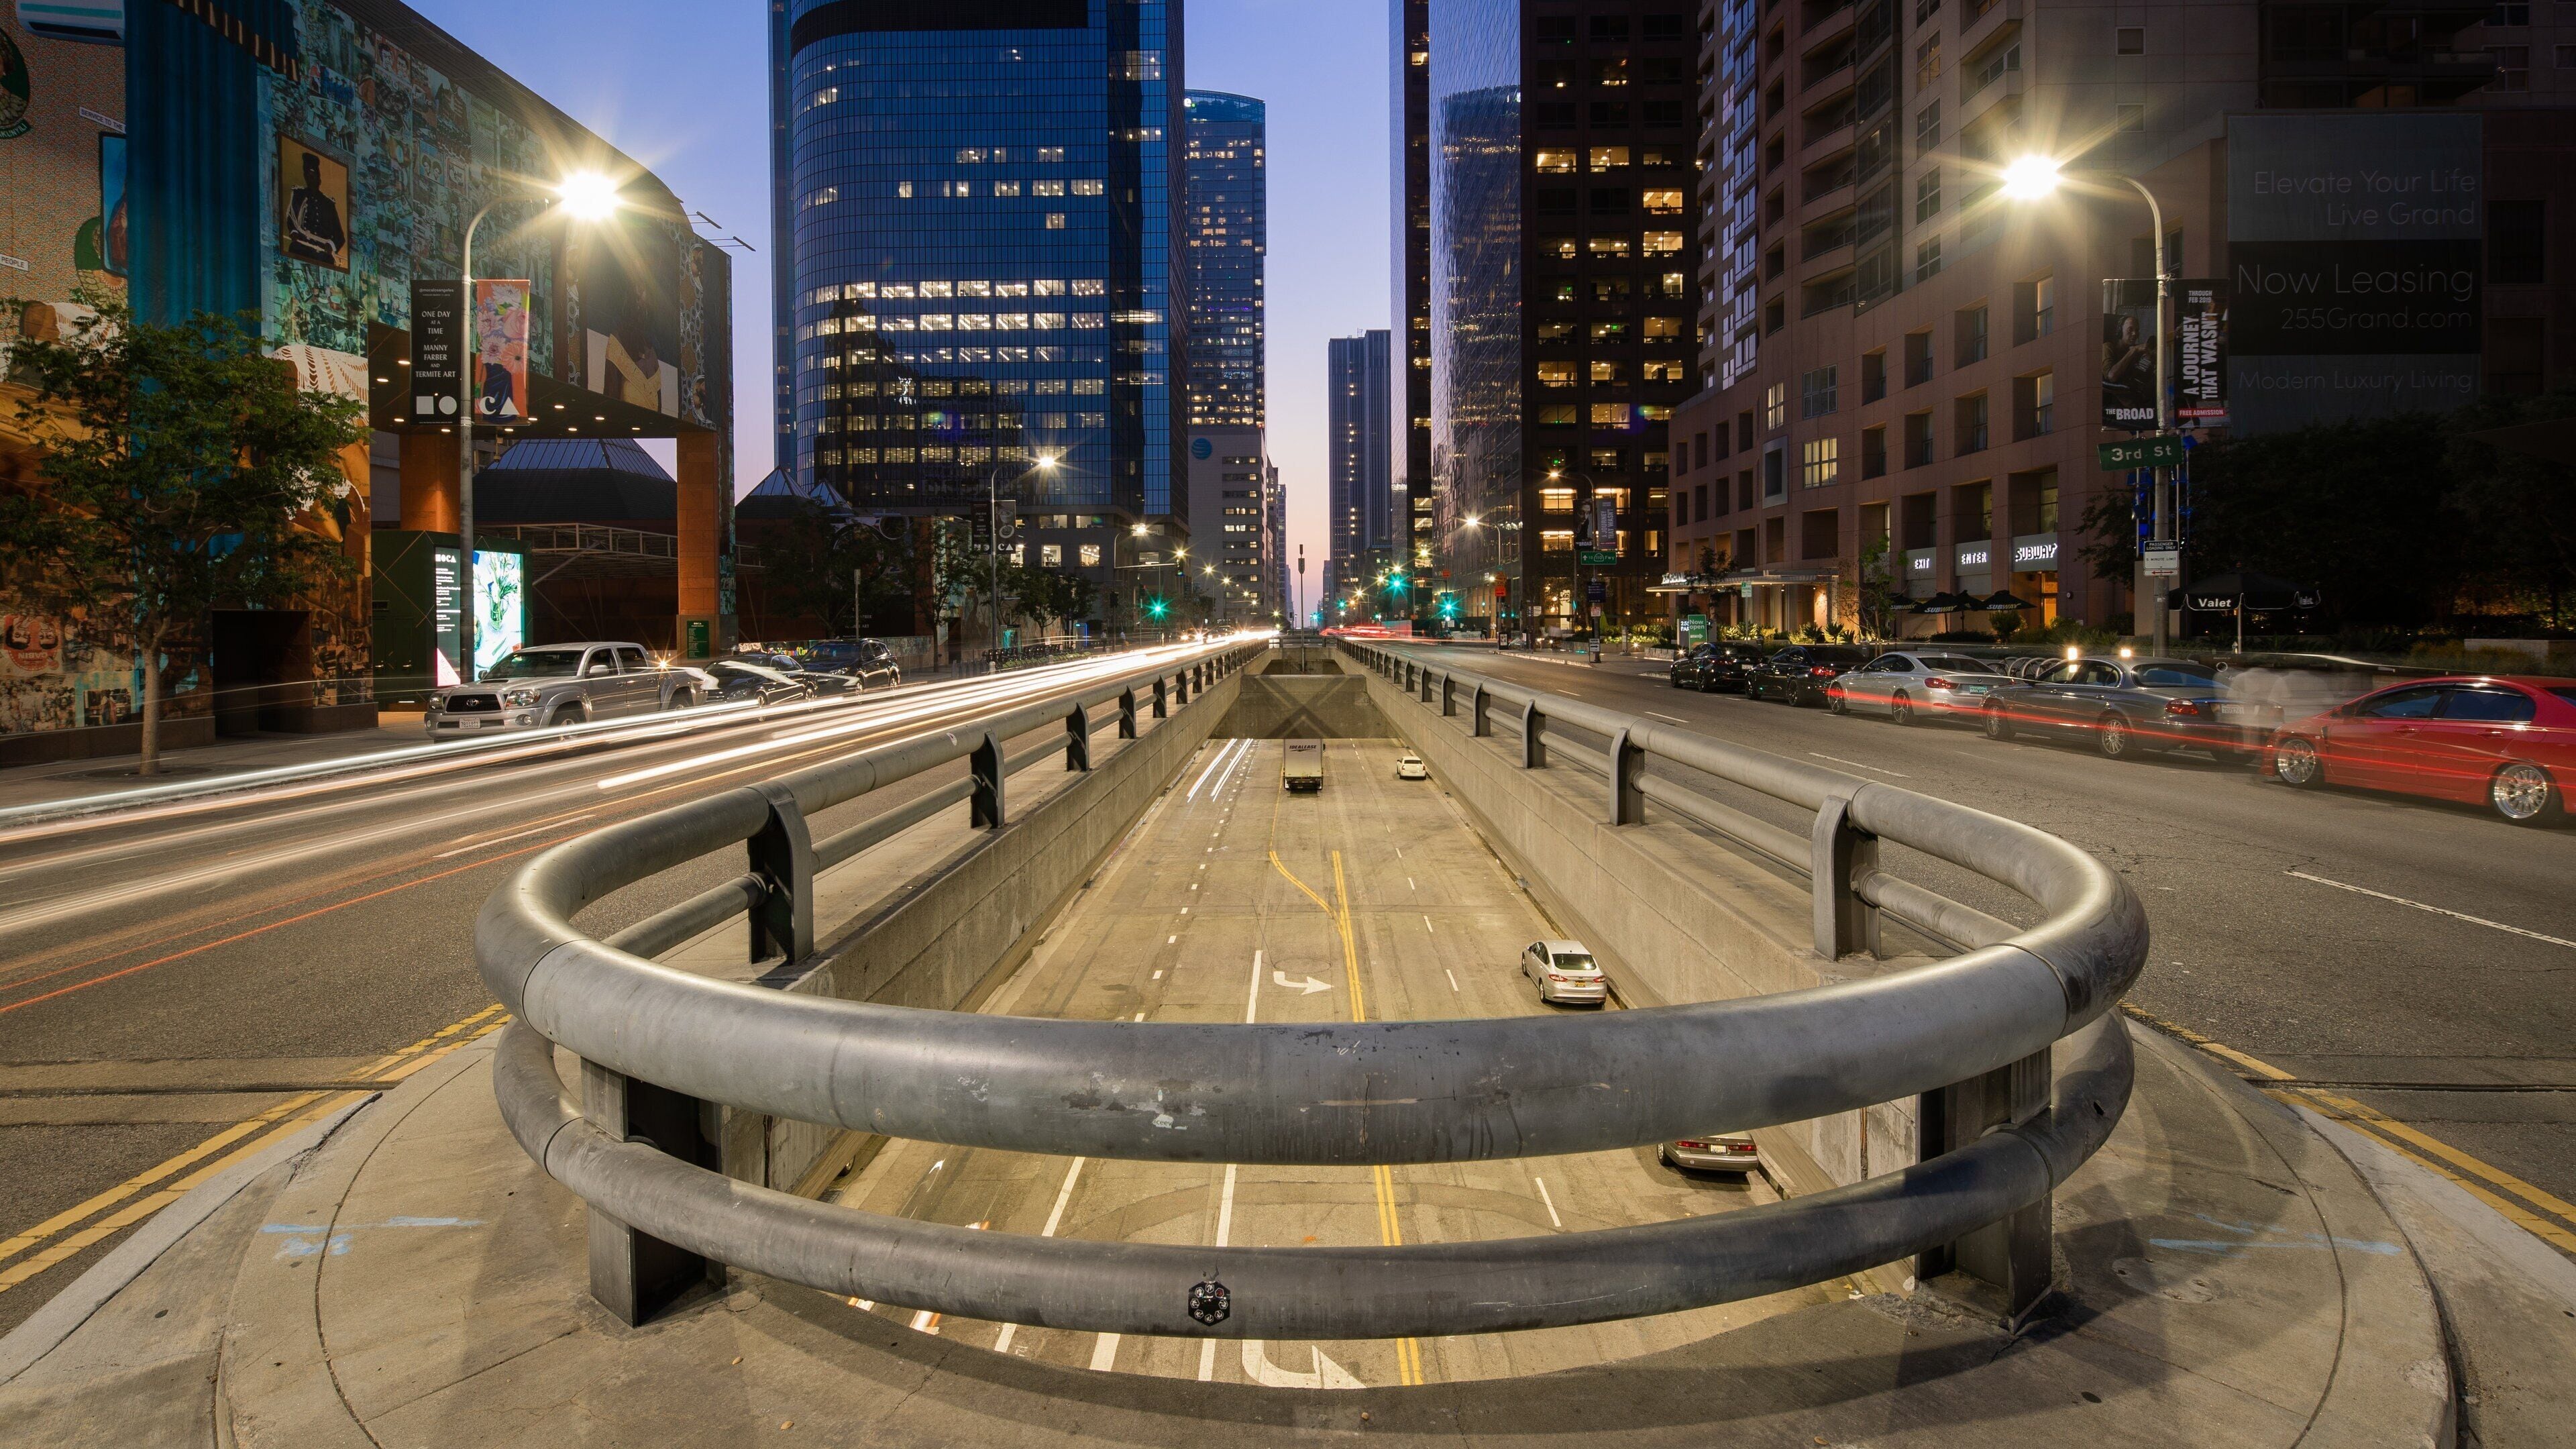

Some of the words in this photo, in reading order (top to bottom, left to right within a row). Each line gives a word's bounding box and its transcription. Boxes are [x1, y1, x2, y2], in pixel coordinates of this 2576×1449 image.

[80, 109, 104, 123] SERVICE
[113, 121, 123, 131] THE
[2255, 171, 2352, 194] Elevate
[2361, 170, 2422, 193] Your
[2431, 168, 2476, 193] Life
[2328, 203, 2379, 225] Live
[2388, 201, 2475, 225] Grand
[1, 256, 25, 268] PEOPLE
[2238, 264, 2321, 294] Now
[2335, 263, 2473, 302] Leasing
[2281, 307, 2473, 329] 255Grand.com
[2201, 311, 2218, 365] WASN'T
[2183, 316, 2200, 384] JOURNEY
[2184, 386, 2200, 395] A
[2201, 369, 2218, 399] THAT
[2238, 371, 2326, 390] Modern
[2334, 371, 2404, 396] Luxury
[2411, 370, 2473, 393] Living
[2116, 408, 2154, 420] BROAD
[2111, 447, 2142, 462] 3rd
[2153, 445, 2172, 457] St
[1961, 551, 1987, 565] ENTER
[2015, 543, 2058, 562] SUBWAY
[1915, 557, 1930, 570] EXIT
[1925, 605, 1957, 613] SUBWAY
[2198, 598, 2231, 607] Valet
